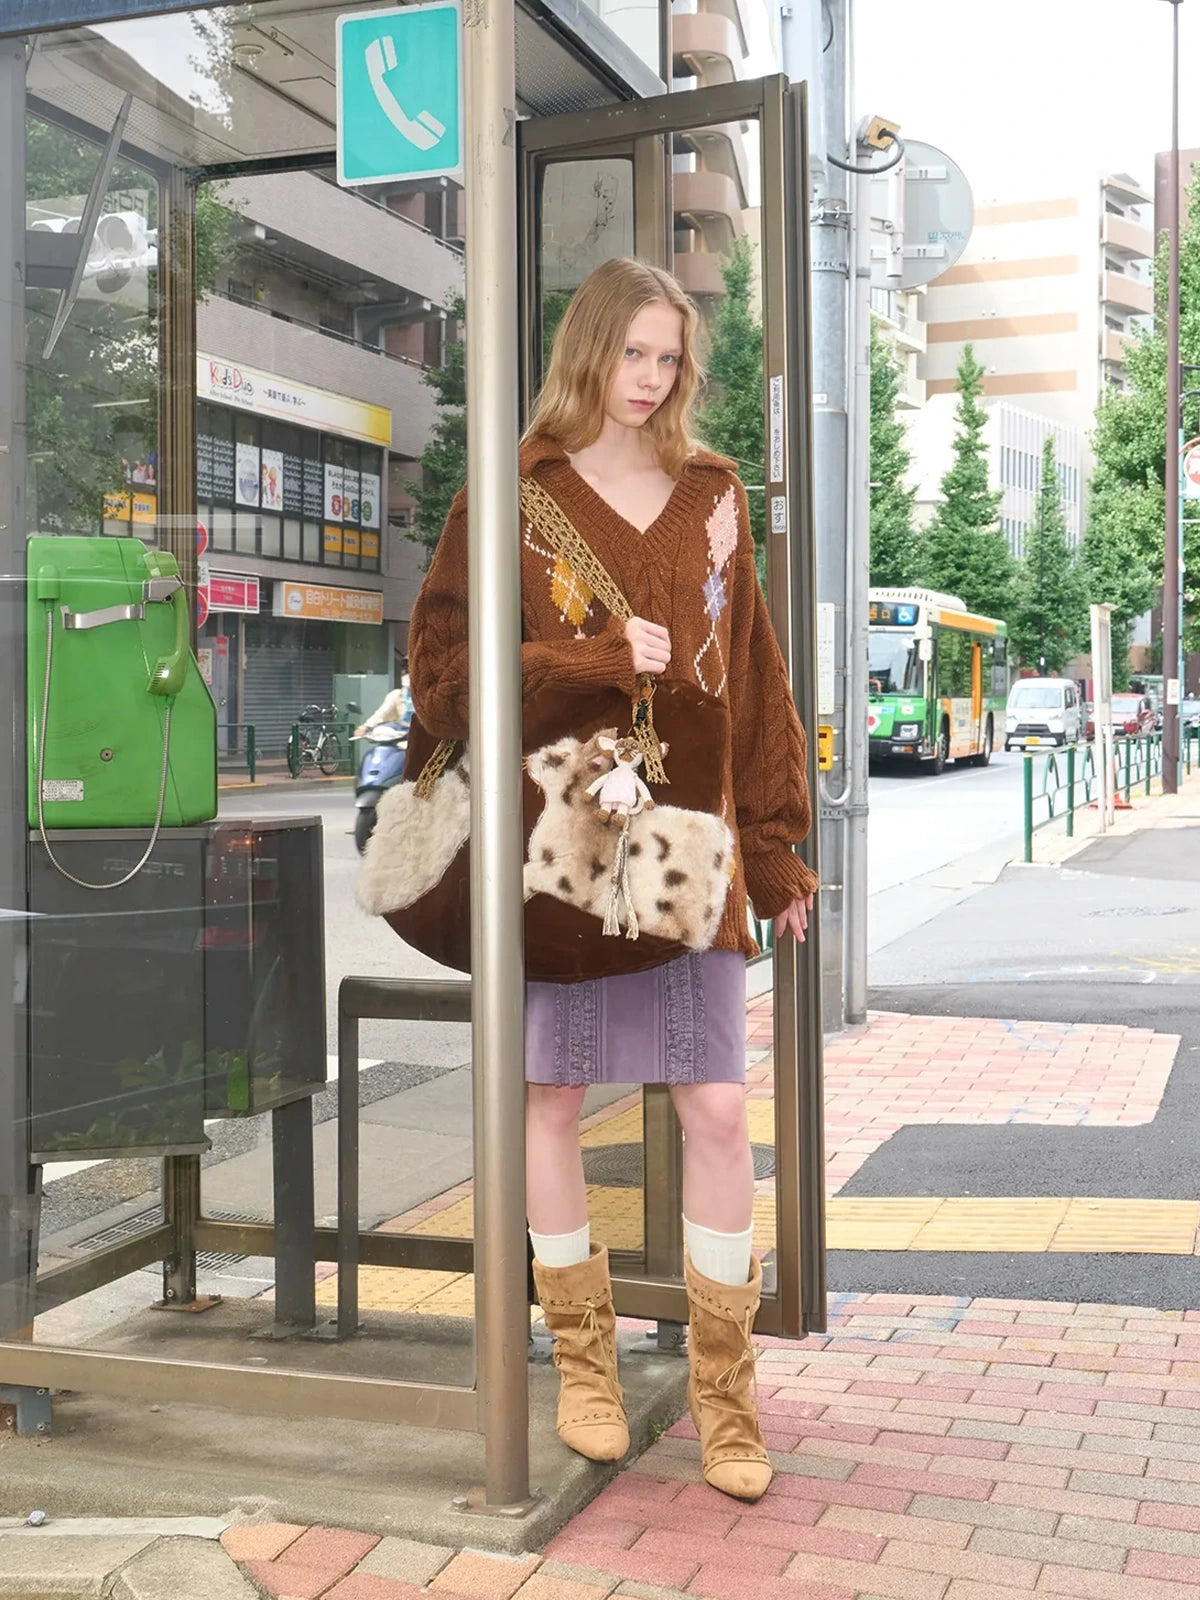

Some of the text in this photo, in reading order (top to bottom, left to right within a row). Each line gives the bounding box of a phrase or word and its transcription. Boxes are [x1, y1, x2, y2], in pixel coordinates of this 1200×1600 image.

[209, 361, 254, 393] Kids Duo
[773, 500, 784, 524] おす
